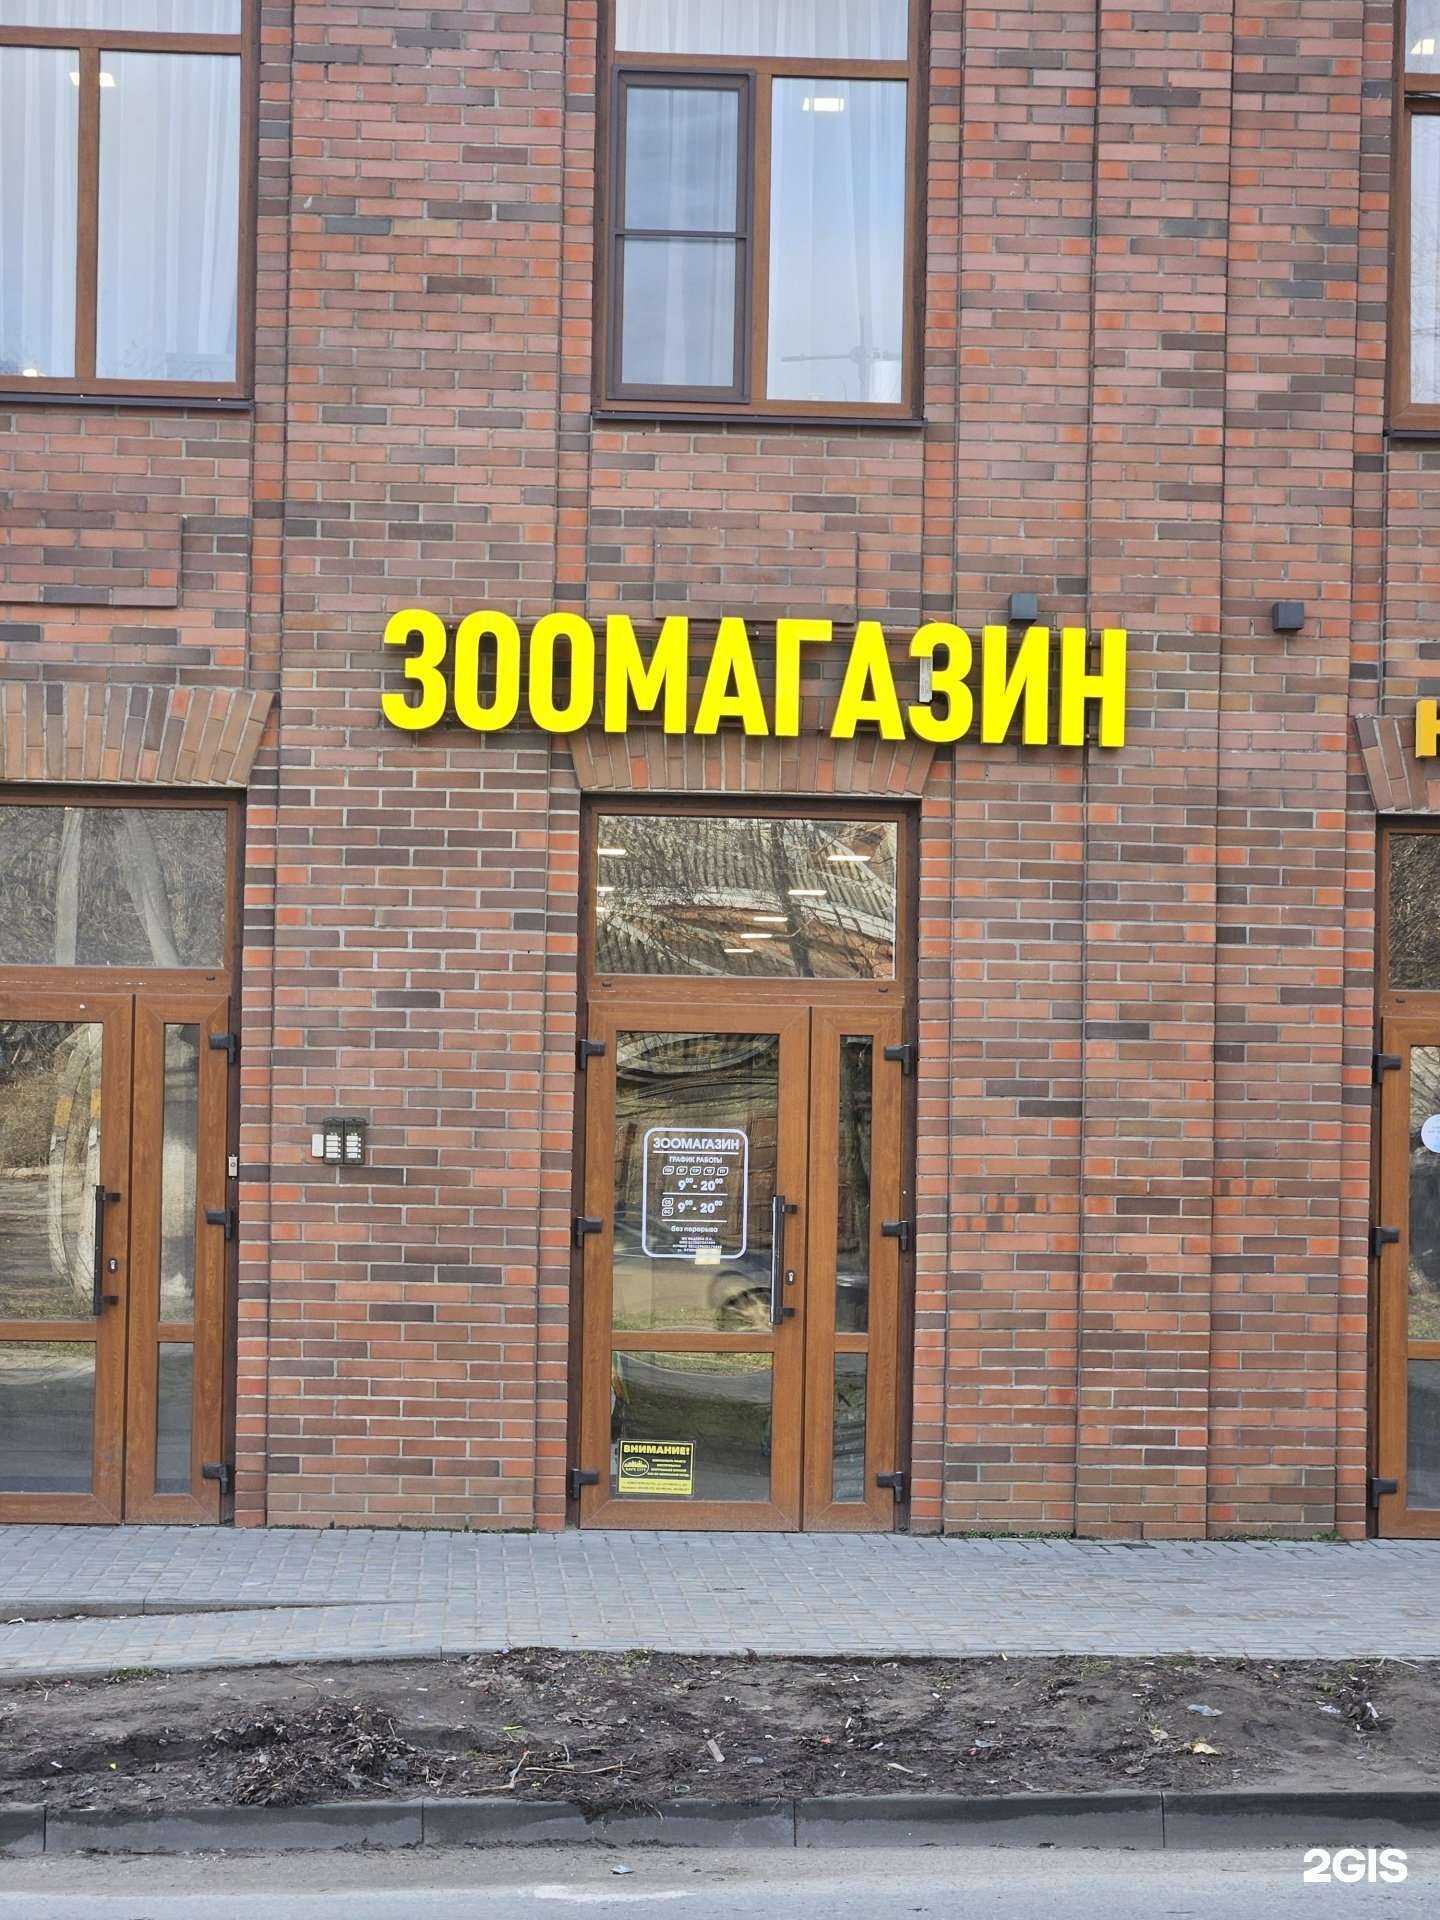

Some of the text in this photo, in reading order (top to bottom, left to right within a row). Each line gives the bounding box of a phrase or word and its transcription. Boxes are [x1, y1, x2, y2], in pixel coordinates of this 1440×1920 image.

[381, 609, 1128, 749] ЗООМАГАЗИН
[652, 1136, 740, 1151] ЗООМАГАЗИН
[696, 1156, 723, 1165] РАБОТЫ
[623, 1444, 690, 1455] ВНИМАНИЕ!
